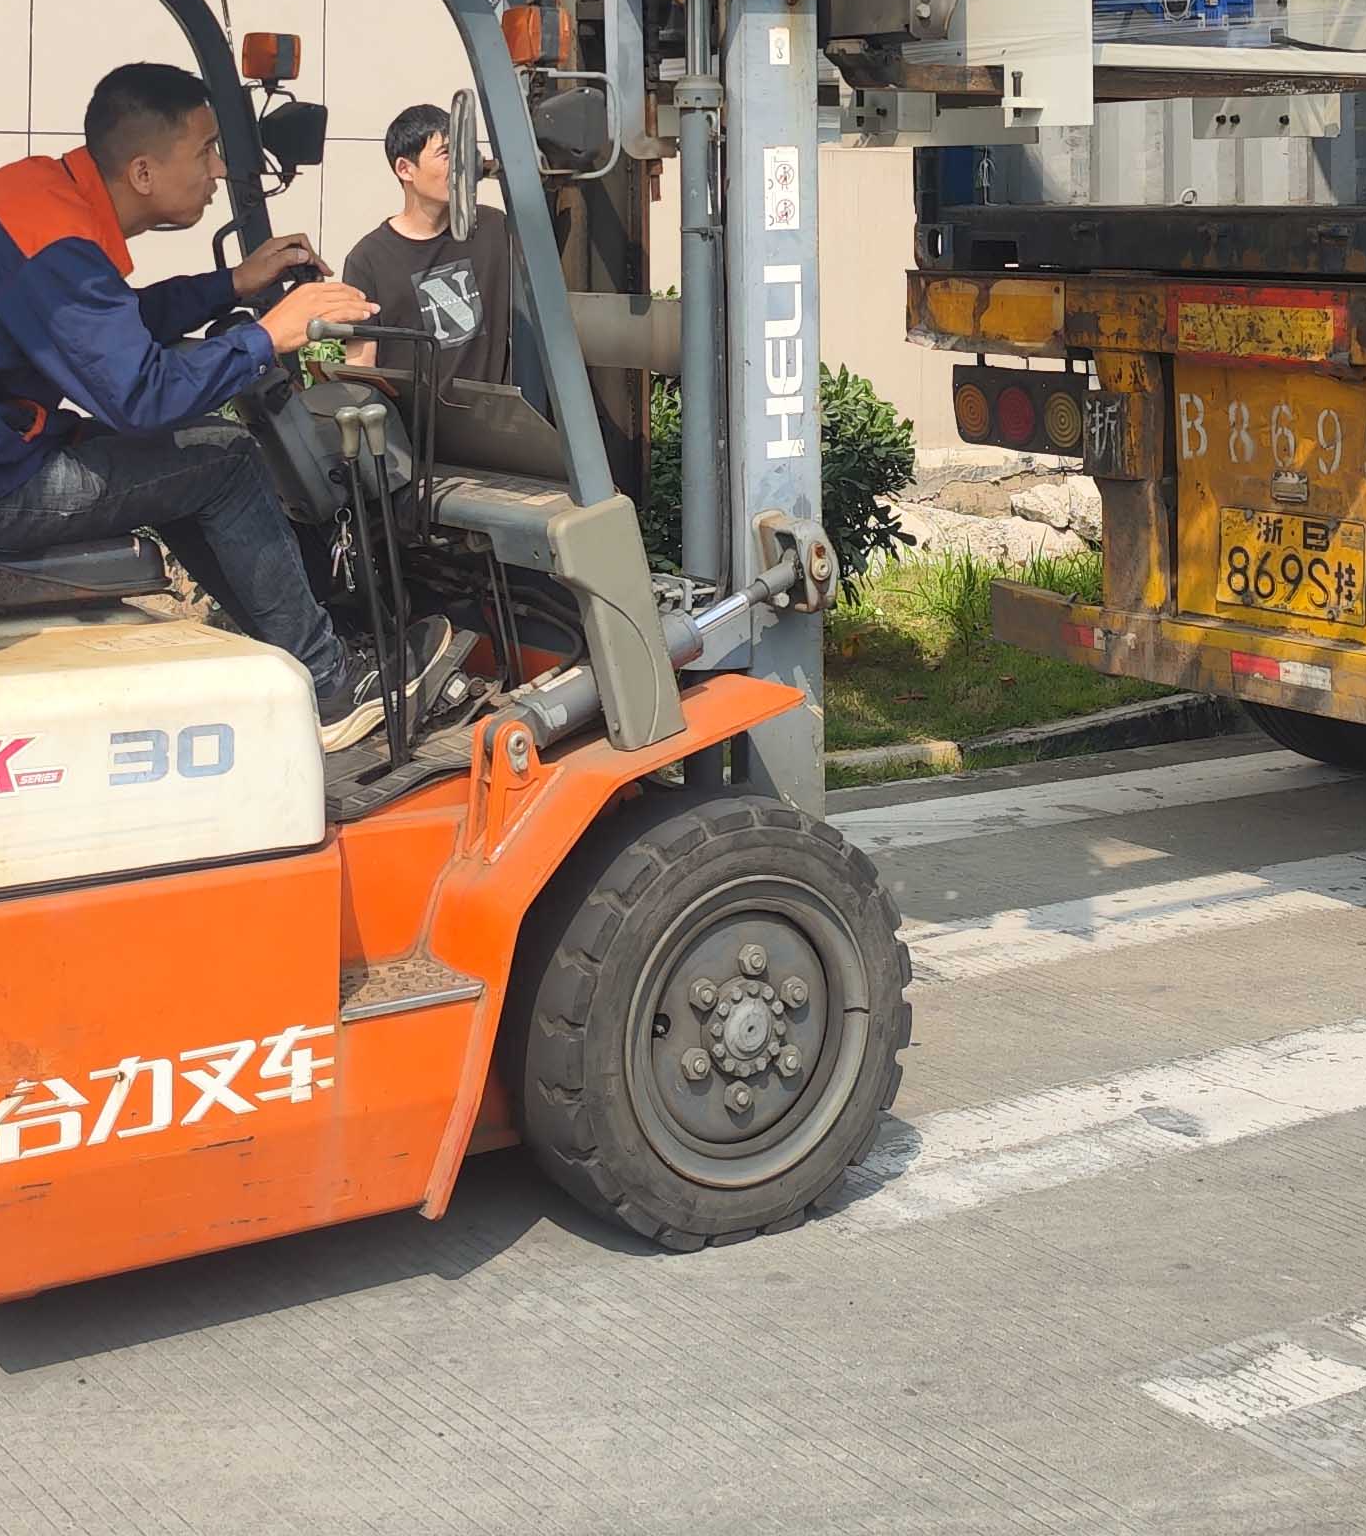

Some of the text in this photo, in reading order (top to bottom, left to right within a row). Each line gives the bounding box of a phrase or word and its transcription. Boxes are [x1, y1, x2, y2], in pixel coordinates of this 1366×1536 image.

[419, 270, 476, 340] N
[763, 264, 805, 460] HELI
[1227, 546, 1356, 615] 869S挂
[108, 722, 236, 787] 30
